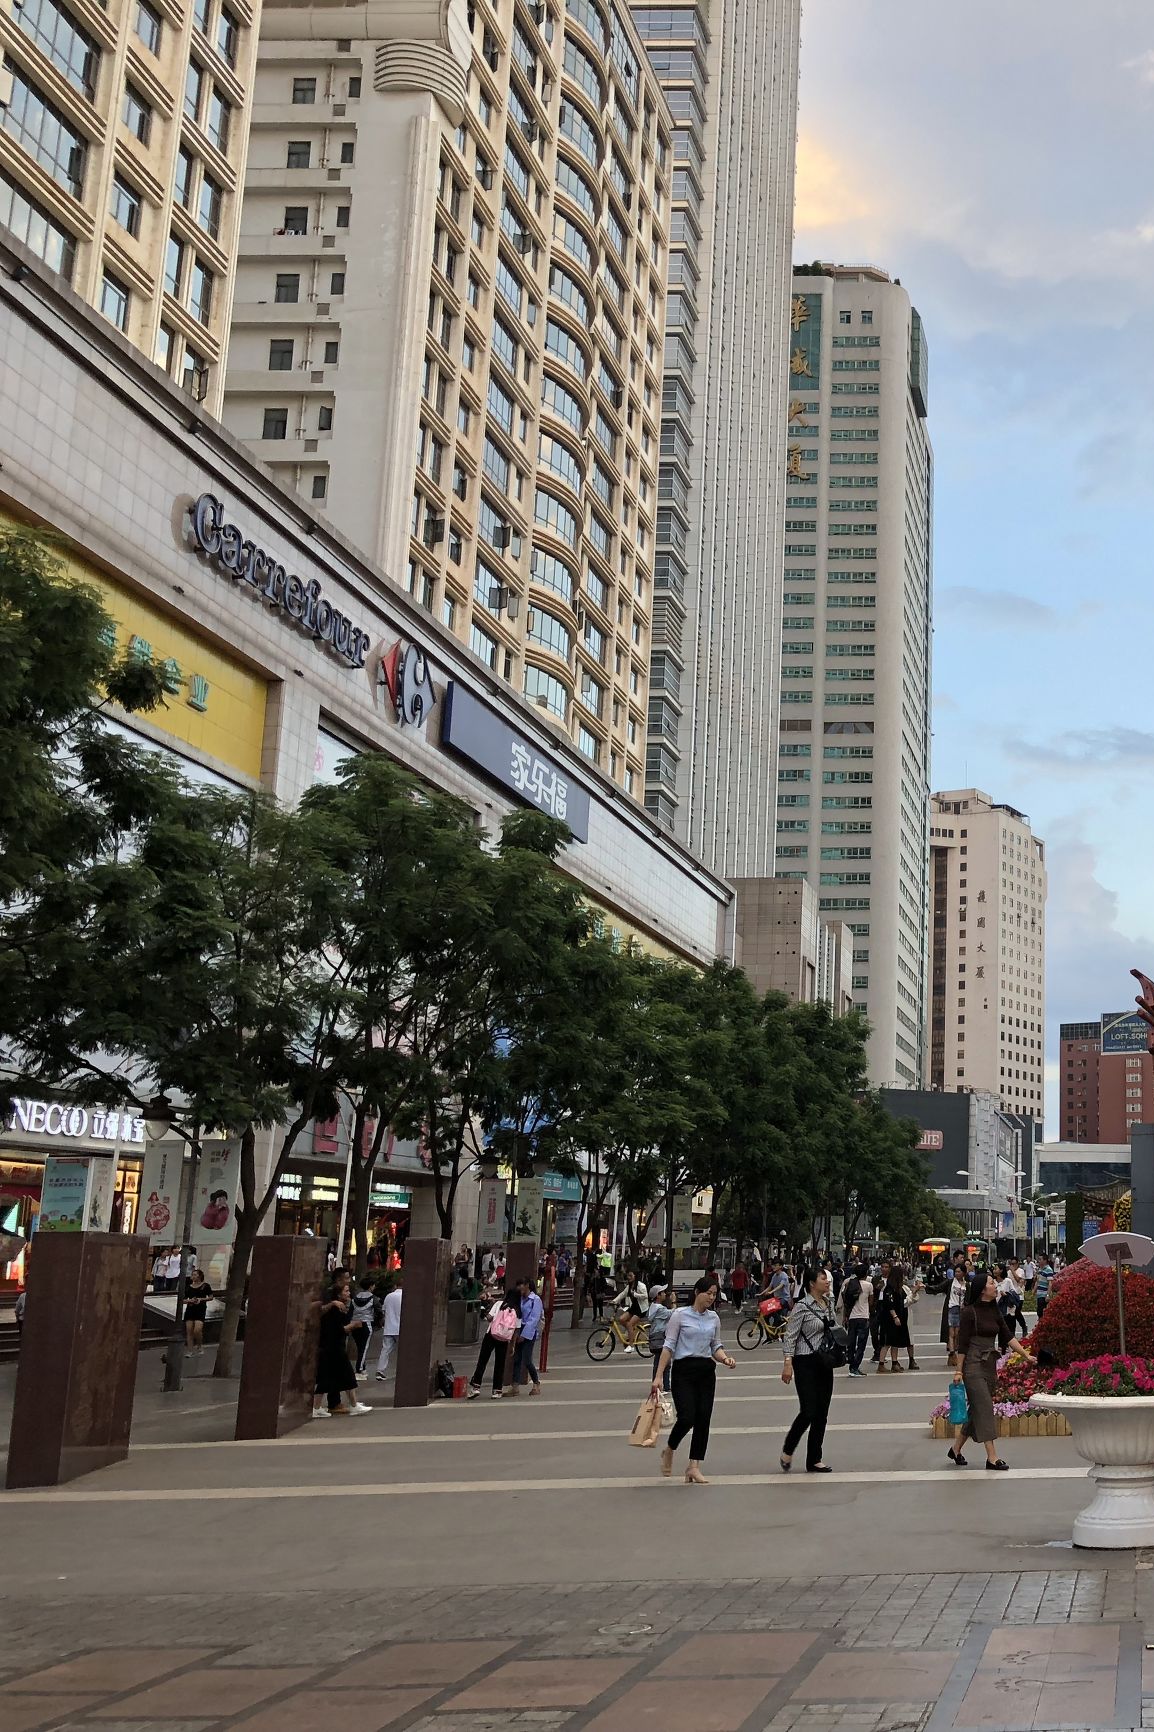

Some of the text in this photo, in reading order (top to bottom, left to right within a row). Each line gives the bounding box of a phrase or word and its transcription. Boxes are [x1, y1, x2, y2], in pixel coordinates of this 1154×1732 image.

[190, 491, 371, 669] Carrefour
[510, 740, 569, 821] 家乐福
